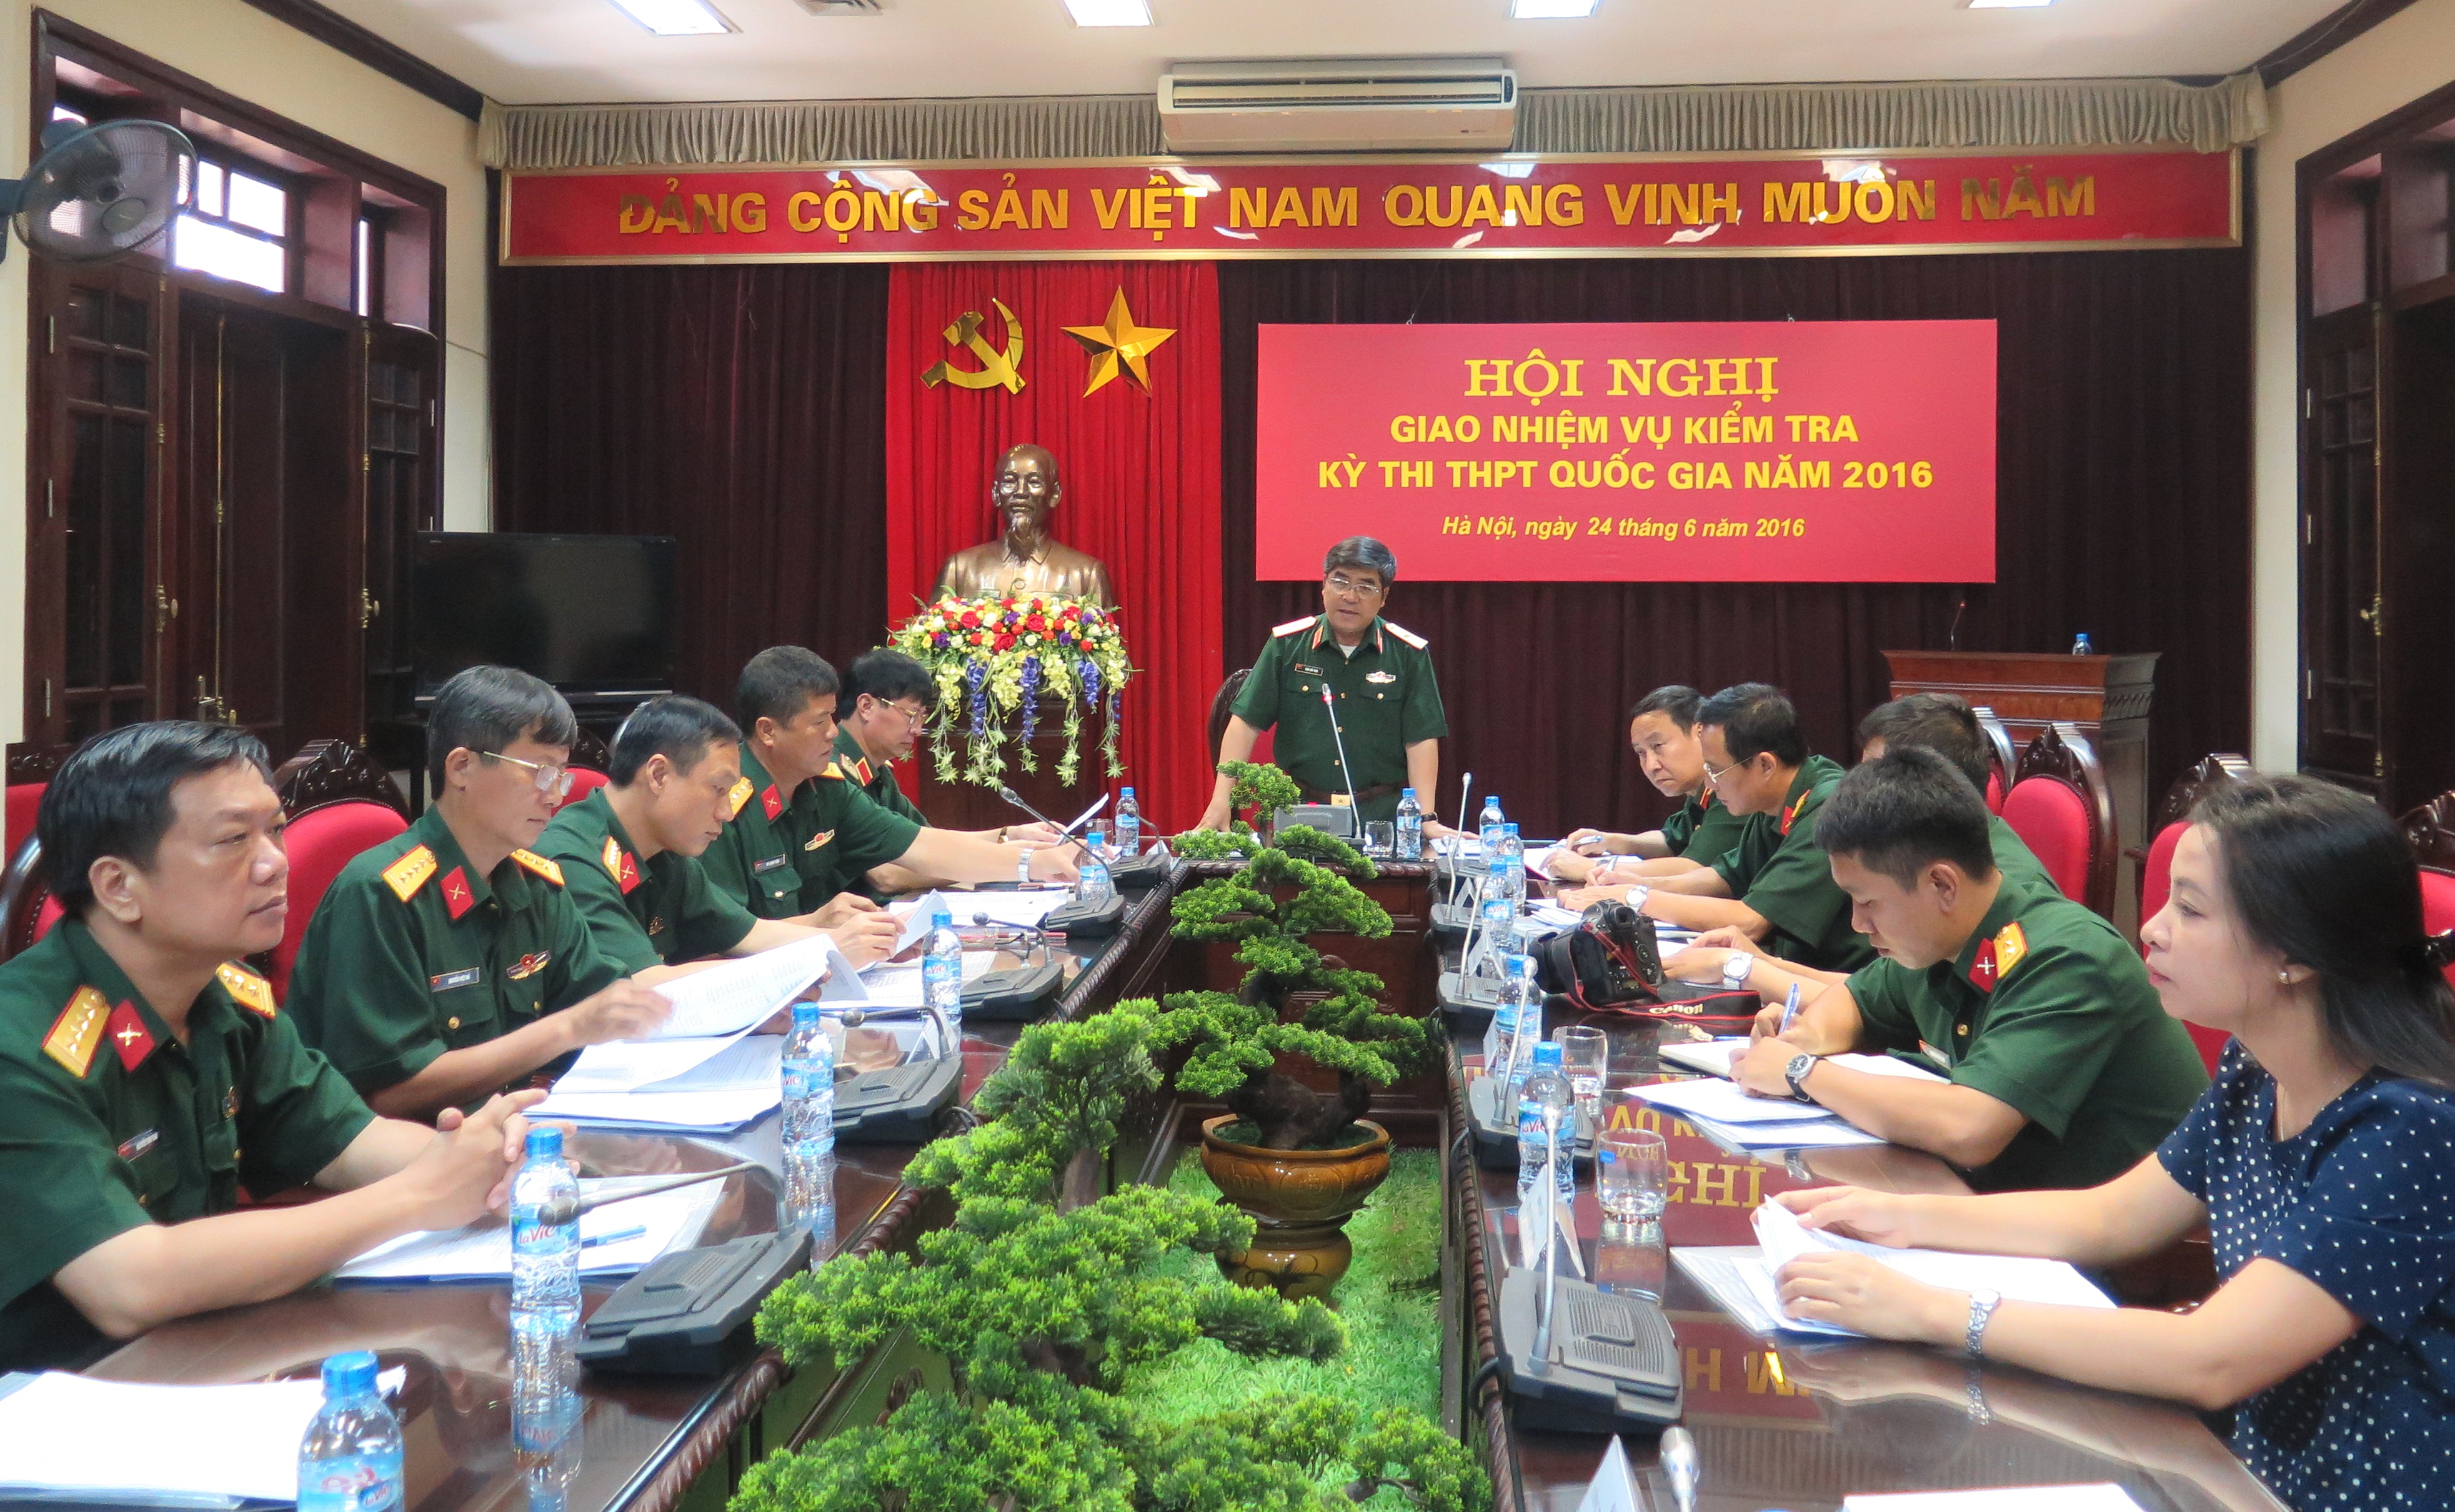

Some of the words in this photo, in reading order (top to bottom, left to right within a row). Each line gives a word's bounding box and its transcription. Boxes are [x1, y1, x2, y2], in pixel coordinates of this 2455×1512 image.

[619, 177, 767, 234] ĐẢNG
[787, 179, 939, 243] CỘNG
[957, 172, 1068, 230] SẢN
[1091, 175, 1198, 241] VIỆT
[1229, 187, 1358, 228] NAM
[1385, 184, 1585, 227] QUANG
[1604, 183, 1738, 226] VINH
[1961, 164, 2096, 221] NĂM
[1464, 348, 1585, 407] HỘI
[1607, 357, 1780, 403] NGHỊ
[1390, 415, 1481, 443] GIAO
[1493, 409, 1609, 450] NHIỆM
[1620, 416, 1673, 450] VỤ
[1684, 400, 1774, 444] KIỂM
[1785, 415, 1860, 442] TRA
[1318, 453, 1367, 489] KỲ
[1378, 461, 1434, 488] THI
[1446, 461, 1539, 488] THPT
[1549, 448, 1655, 489] QUỐC
[1667, 462, 1733, 490] GIA
[1745, 454, 1831, 489] NĂM
[1843, 461, 1935, 489] 2016
[1443, 517, 1472, 535] Hà
[1477, 517, 1517, 539] Nội,
[1525, 518, 1578, 542] ngày
[1588, 518, 1613, 536] 24
[1619, 518, 1680, 542] tháng
[1685, 519, 1697, 537] 6
[1702, 519, 1749, 537] năm
[1756, 519, 1805, 537] 2016
[1648, 1003, 1703, 1015] Canon
